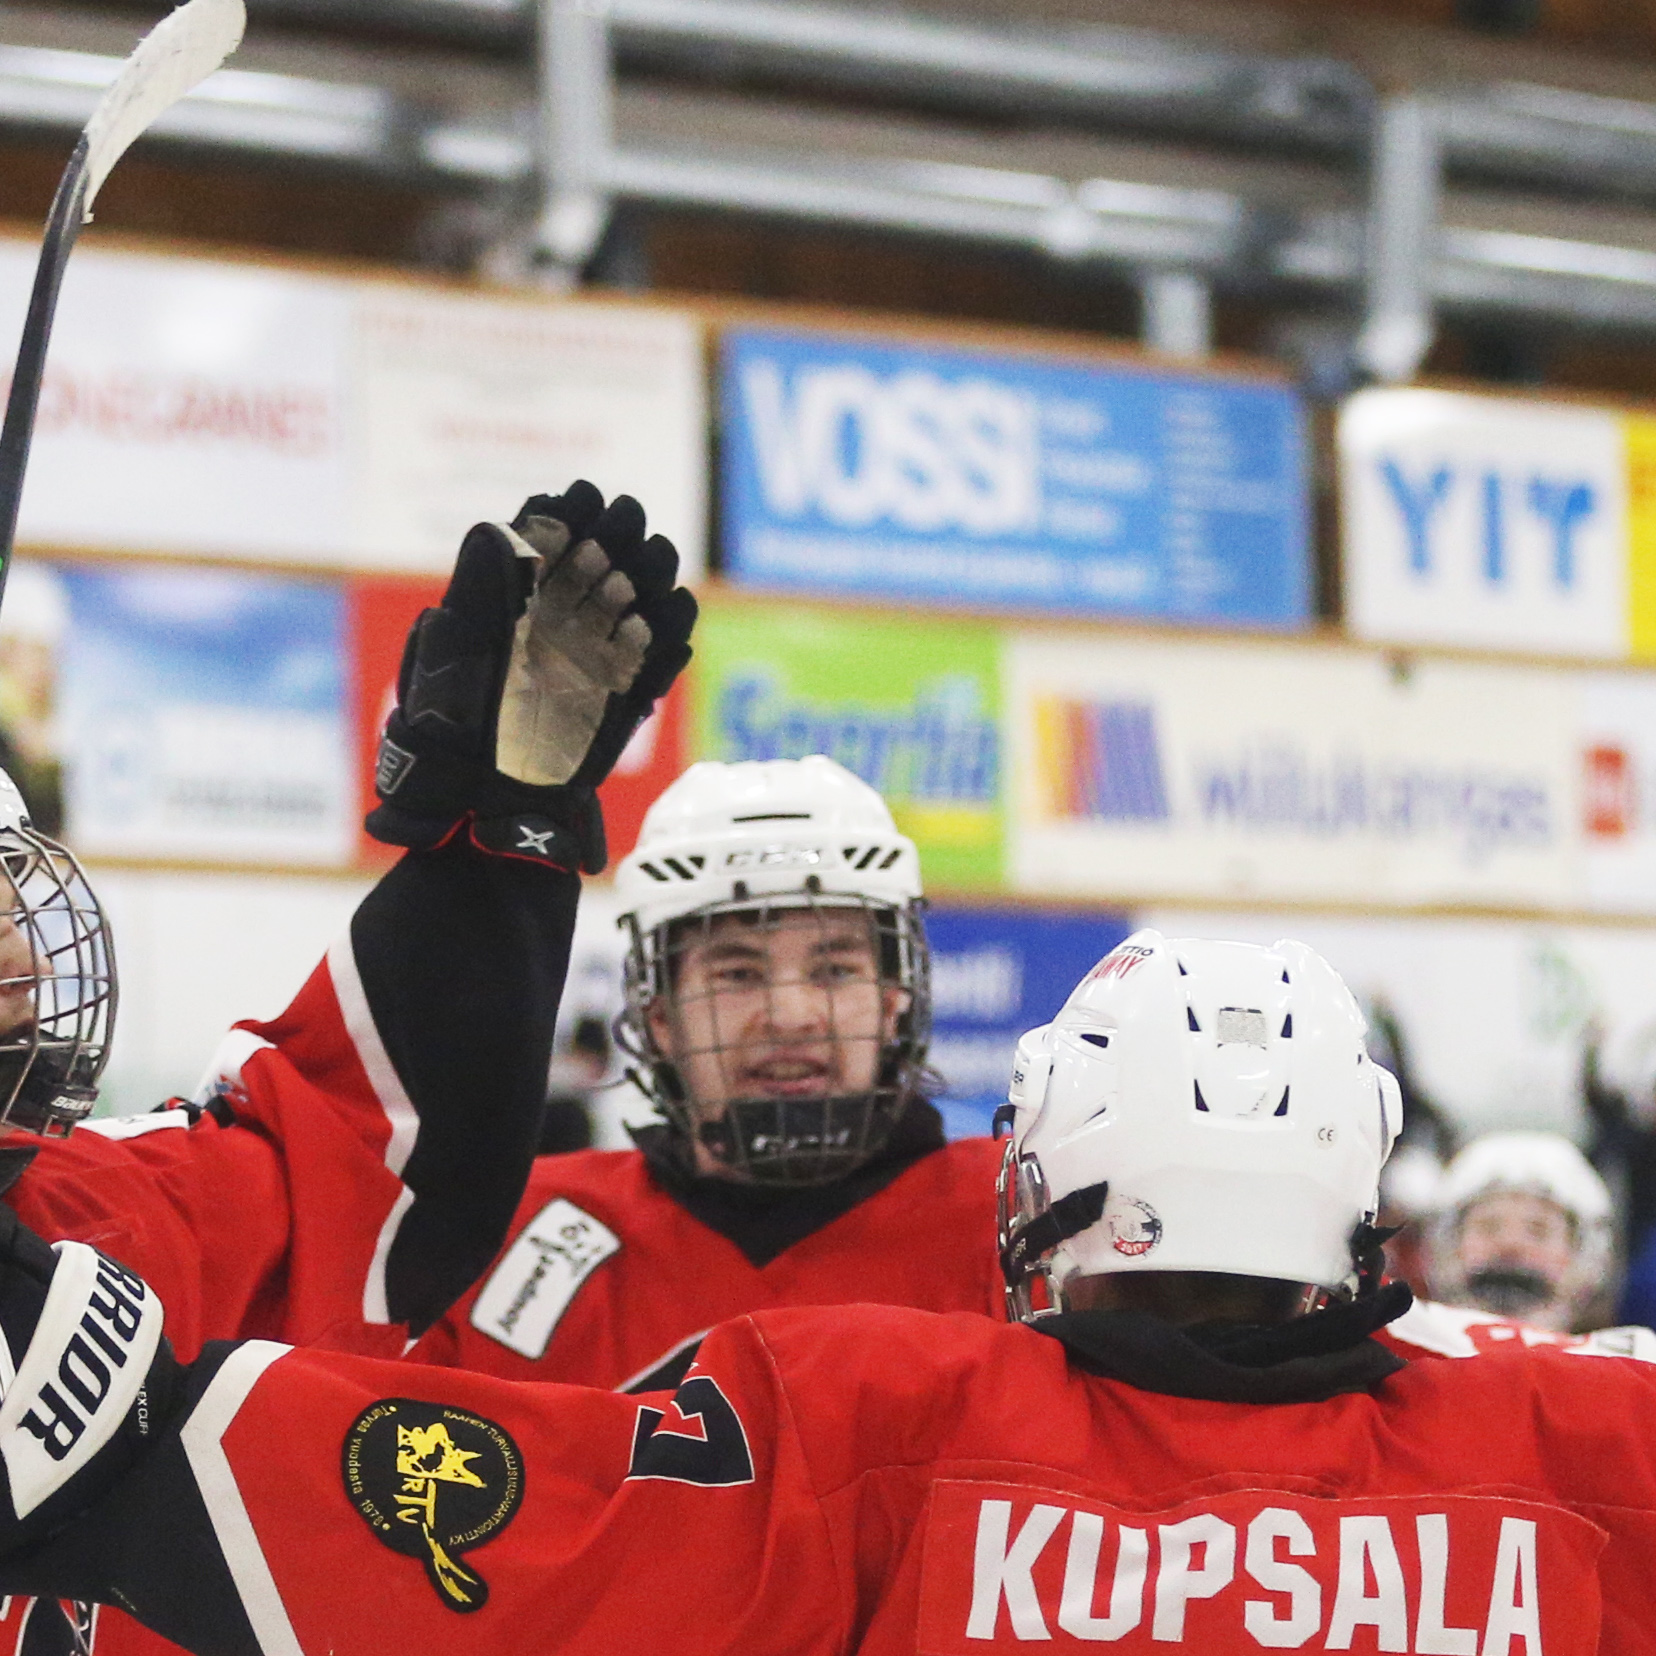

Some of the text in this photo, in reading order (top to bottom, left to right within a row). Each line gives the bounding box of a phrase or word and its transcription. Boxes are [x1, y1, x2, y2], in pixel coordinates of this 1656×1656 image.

[749, 355, 1042, 540] VOSSI
[1376, 450, 1596, 595] YIT
[1317, 1127, 1335, 1143] CE
